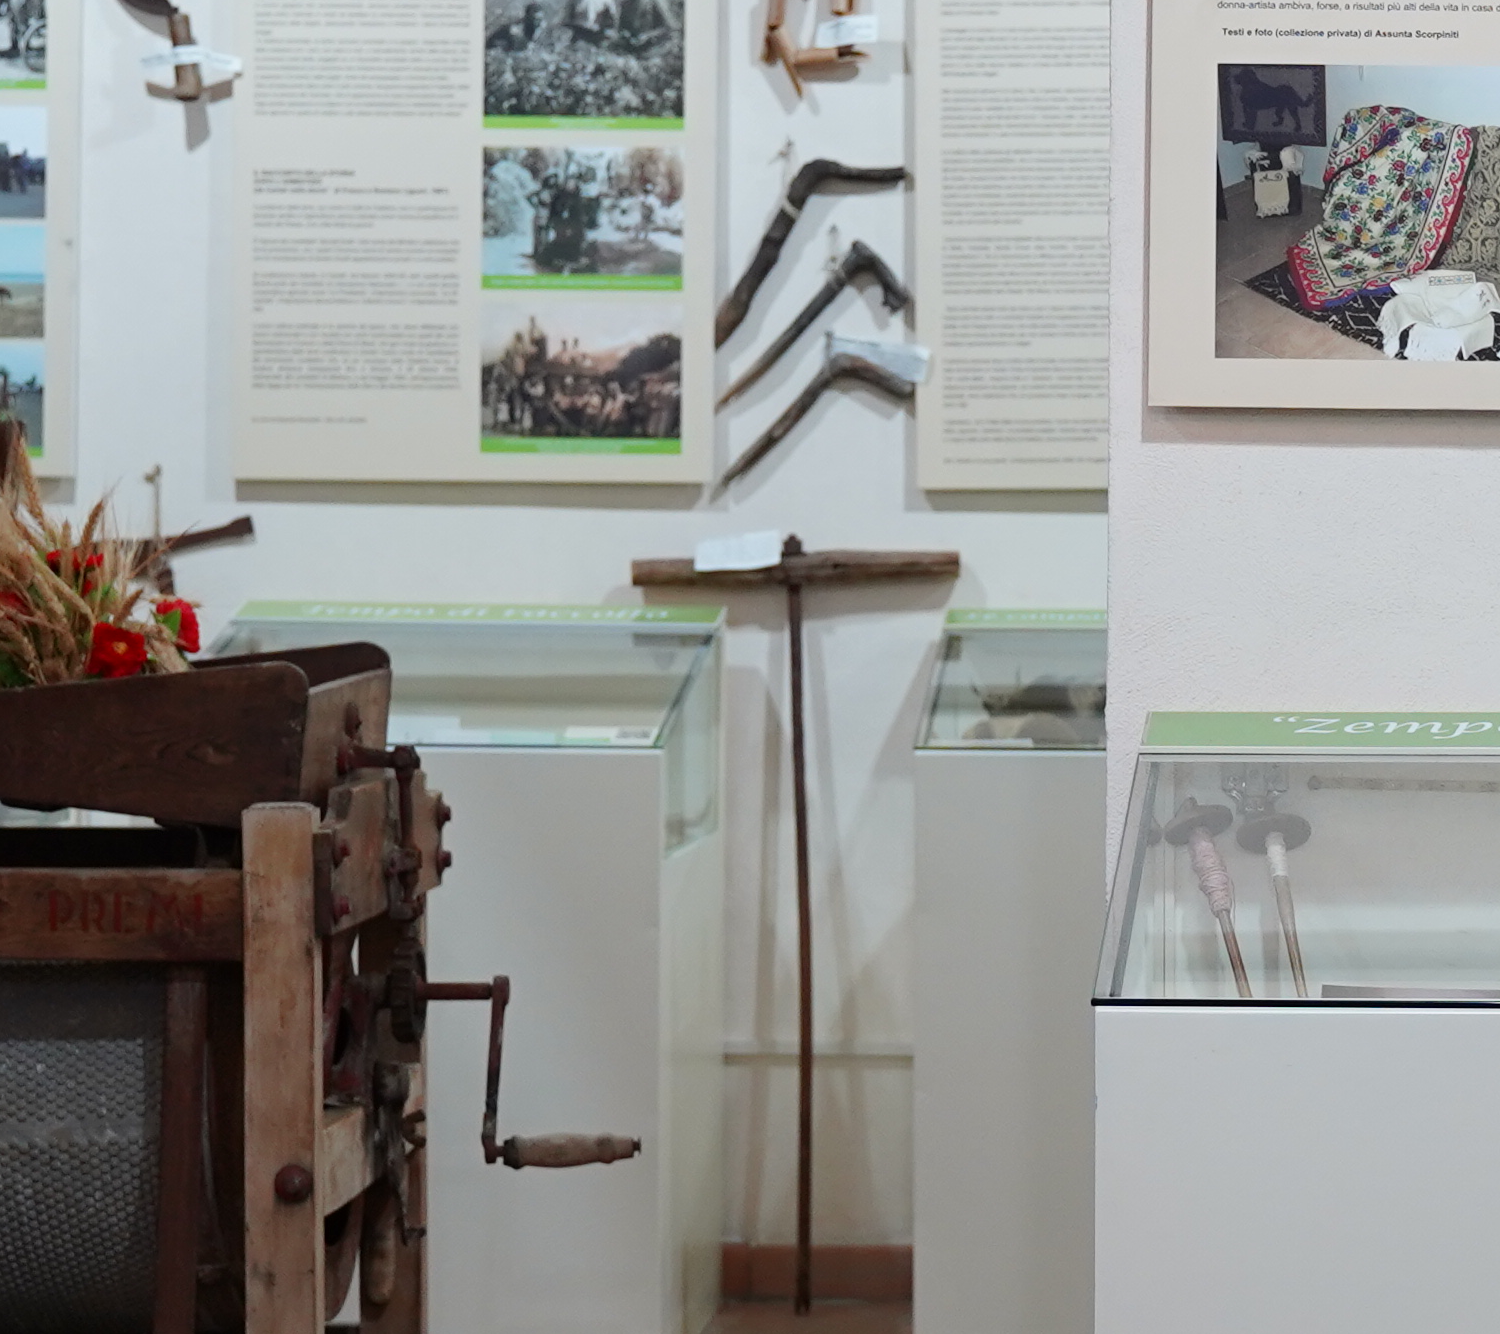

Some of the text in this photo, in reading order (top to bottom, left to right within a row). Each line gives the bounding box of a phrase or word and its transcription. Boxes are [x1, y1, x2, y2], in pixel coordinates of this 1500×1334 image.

[1222, 27, 1244, 36] Testi
[1254, 27, 1273, 36] foto
[1275, 28, 1324, 38] (collezione
[1326, 28, 1361, 39] privata)
[1363, 29, 1372, 37] di
[1374, 29, 1412, 38] Assunta
[1415, 29, 1459, 40] Scorpiniti
